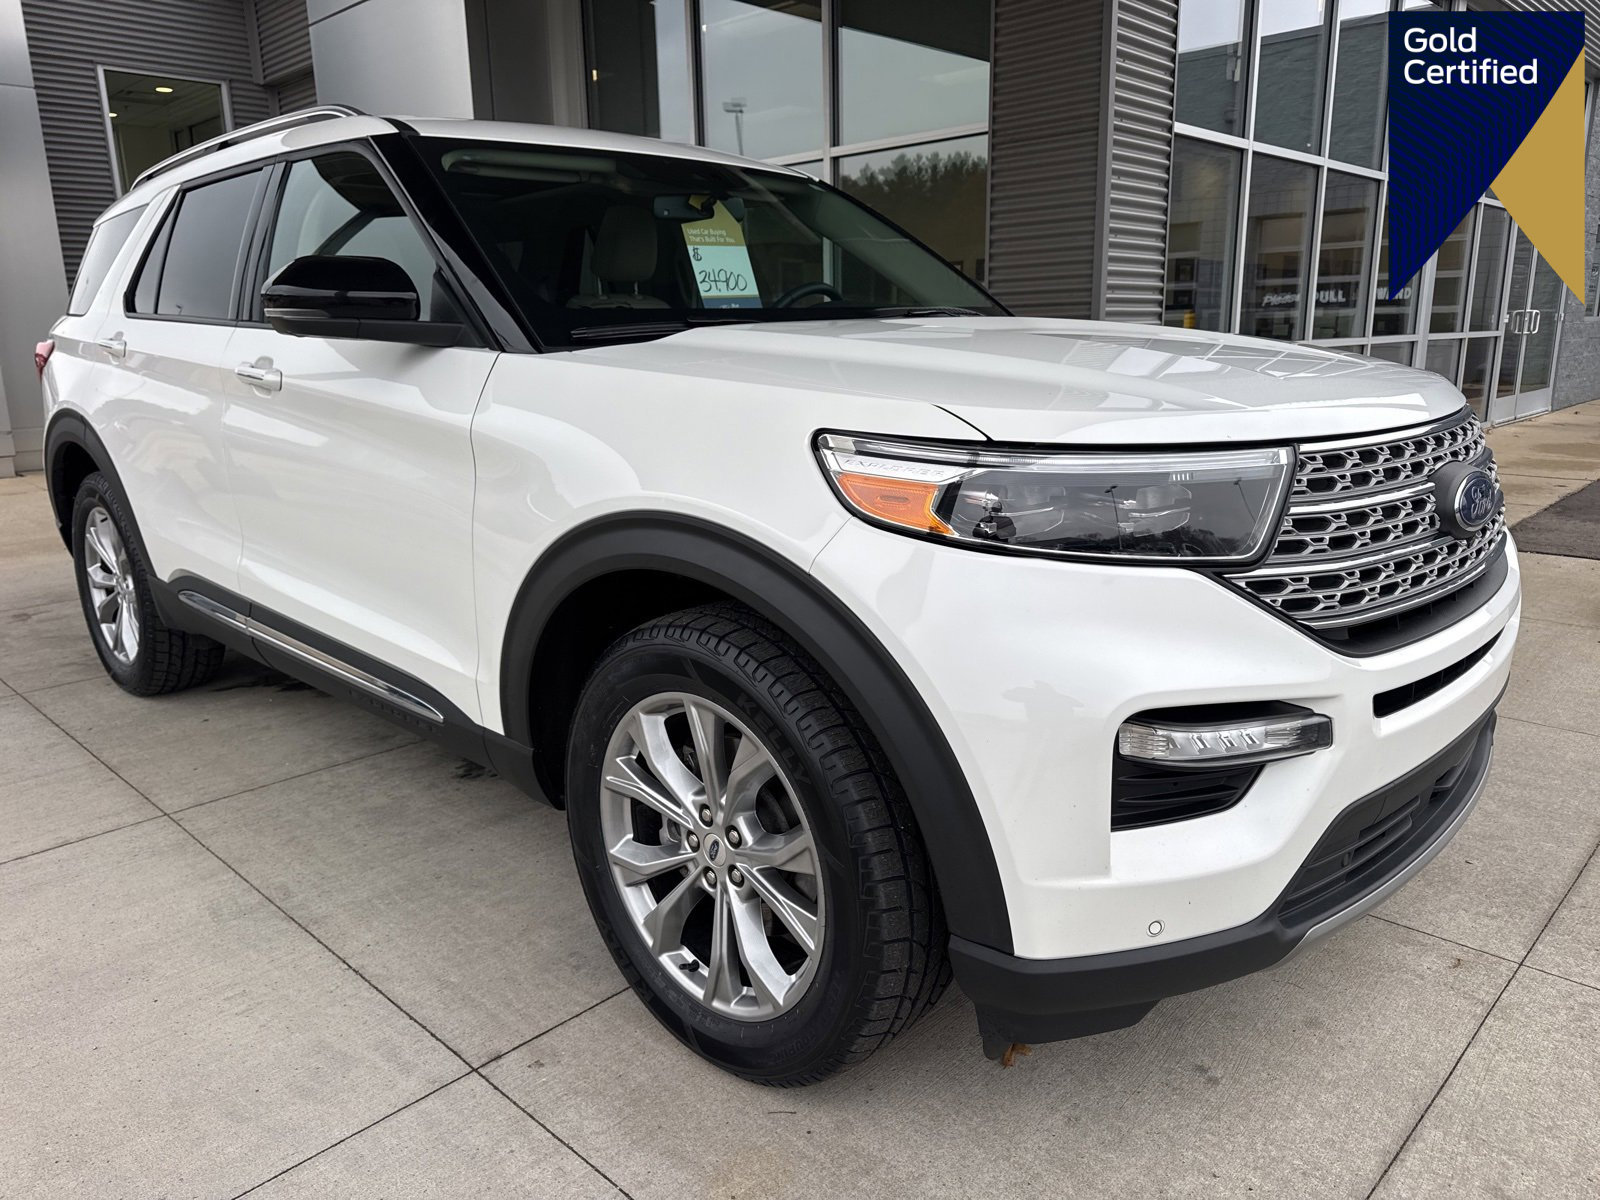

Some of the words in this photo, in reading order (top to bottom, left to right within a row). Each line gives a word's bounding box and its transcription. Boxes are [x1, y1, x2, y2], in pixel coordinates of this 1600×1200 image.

[687, 228, 701, 236] Used
[701, 228, 709, 236] Car
[709, 228, 727, 237] Buying
[1471, 484, 1493, 519] Ford
[736, 692, 812, 785] KELLY
